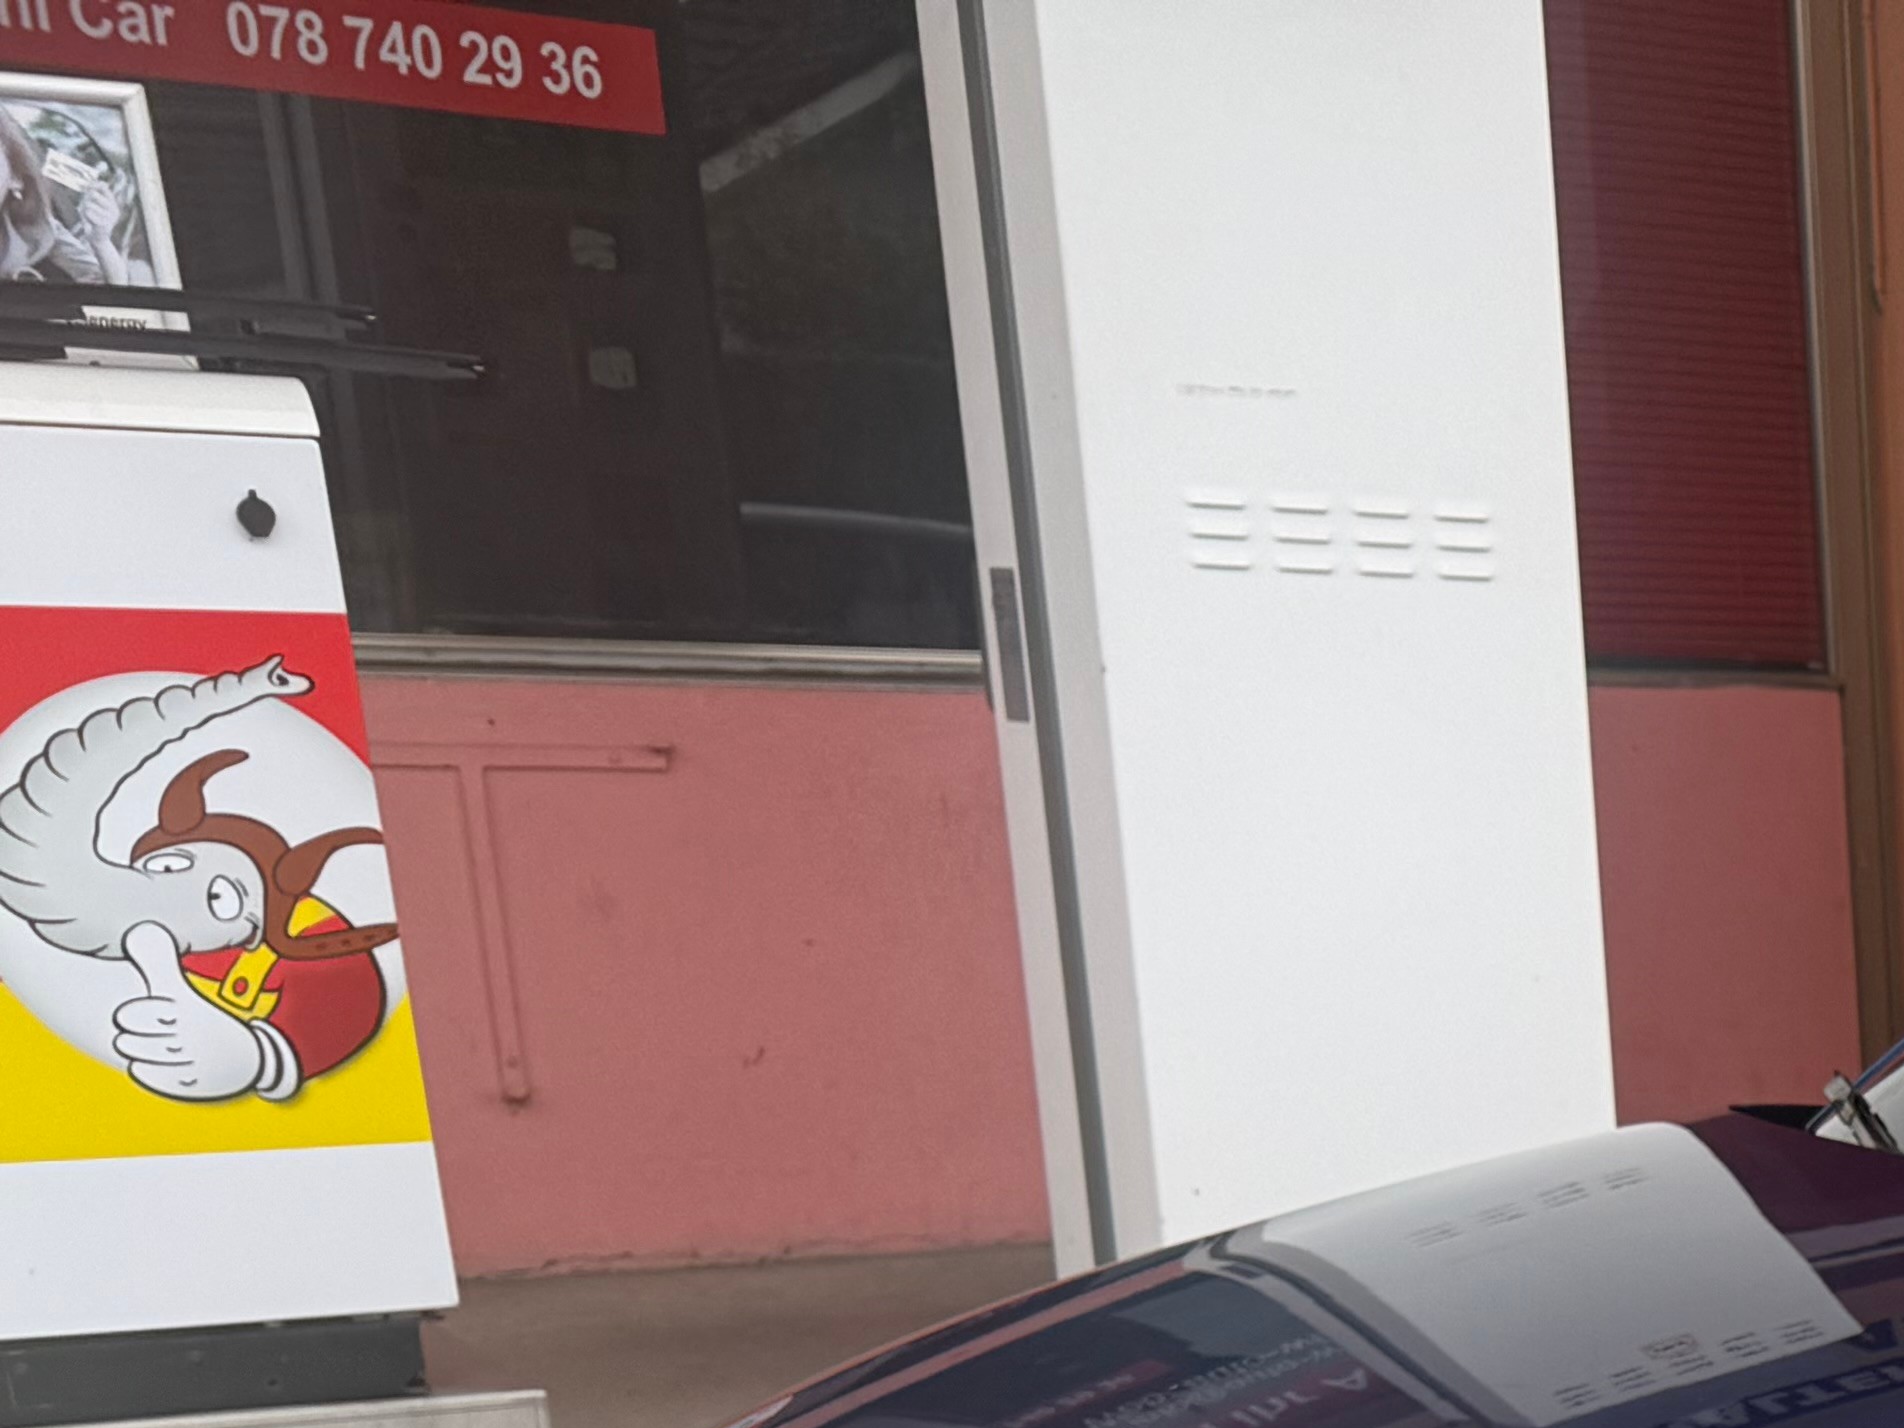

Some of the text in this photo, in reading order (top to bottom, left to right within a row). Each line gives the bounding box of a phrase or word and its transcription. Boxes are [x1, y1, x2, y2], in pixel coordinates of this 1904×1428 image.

[69, 0, 175, 46] Car
[225, 0, 328, 65] 078
[343, 15, 443, 80] 740
[459, 30, 523, 89] 29
[540, 41, 603, 99] 36
